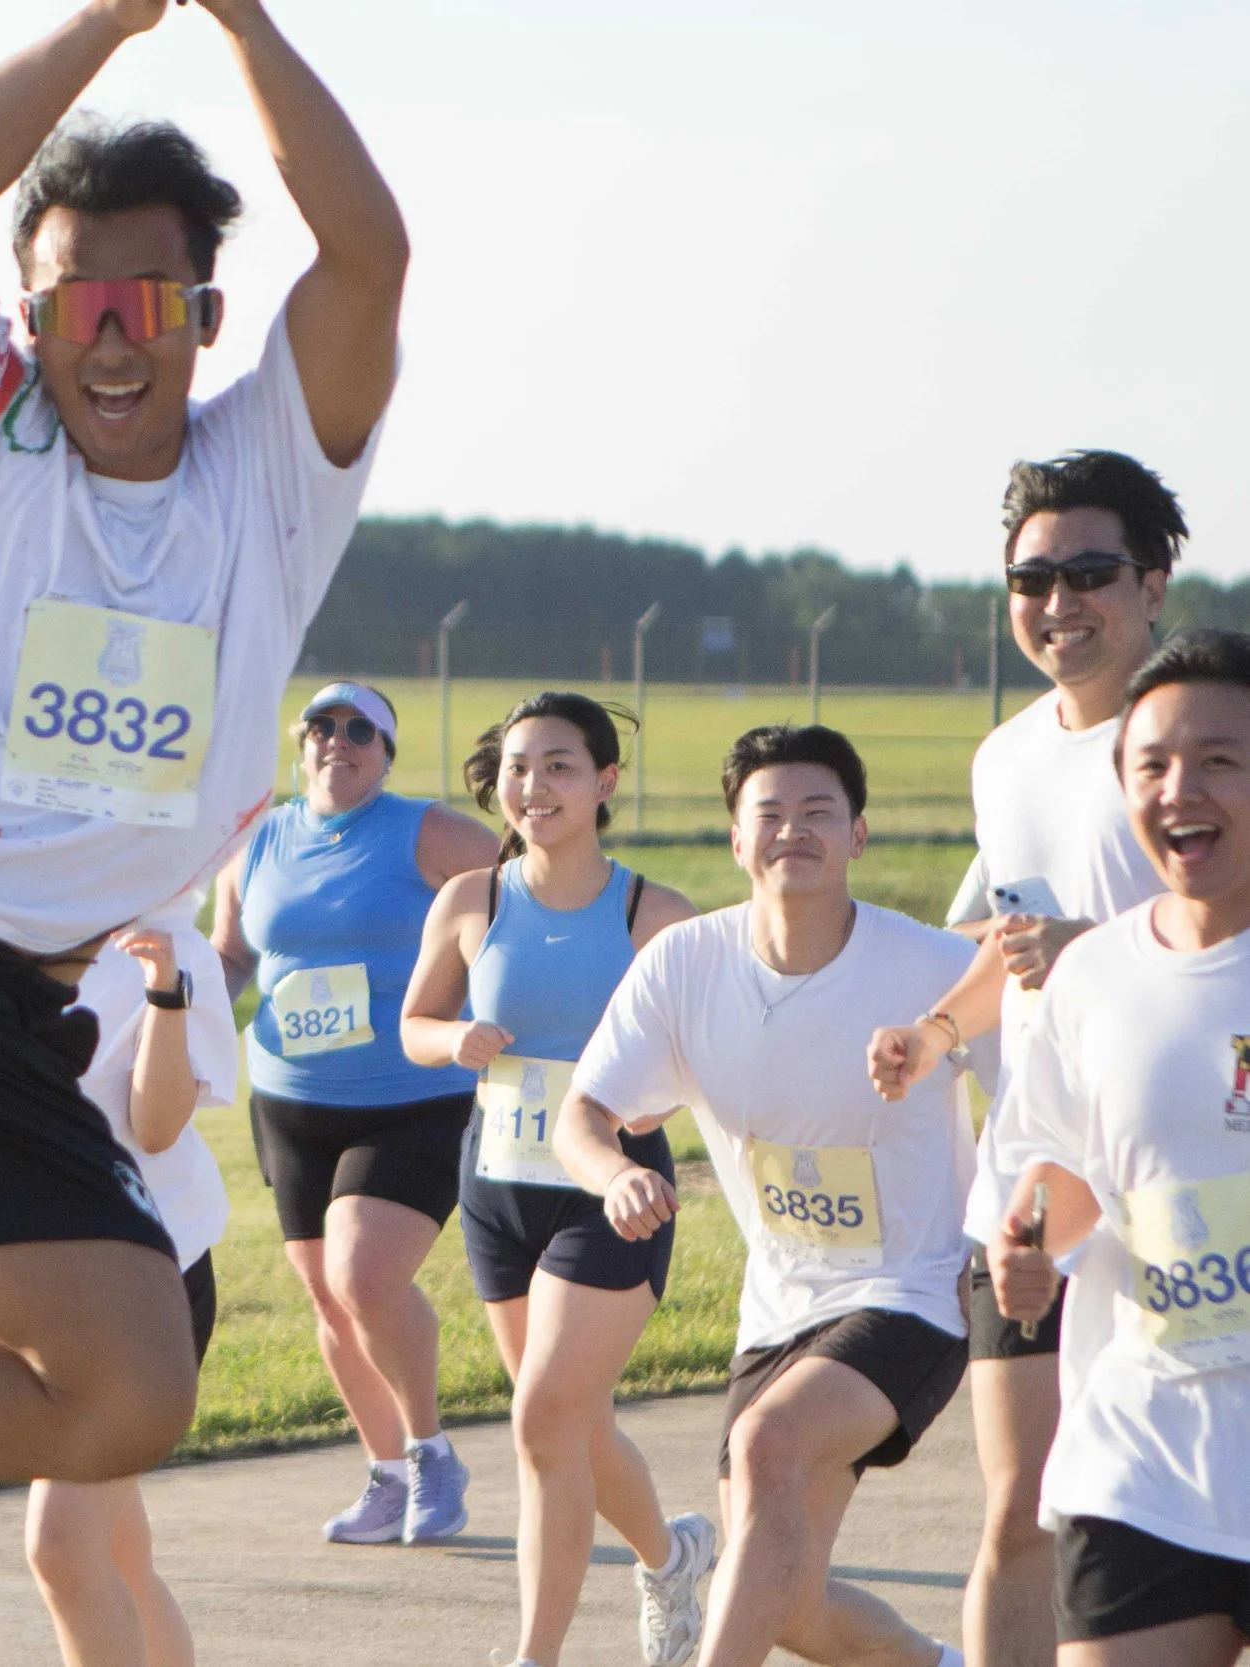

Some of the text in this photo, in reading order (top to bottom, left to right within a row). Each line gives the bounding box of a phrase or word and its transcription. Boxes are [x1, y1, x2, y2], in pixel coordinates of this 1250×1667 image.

[24, 681, 192, 761] 3832
[284, 1003, 356, 1040] 3821
[490, 1105, 548, 1142] 411
[763, 1183, 864, 1228] 3835
